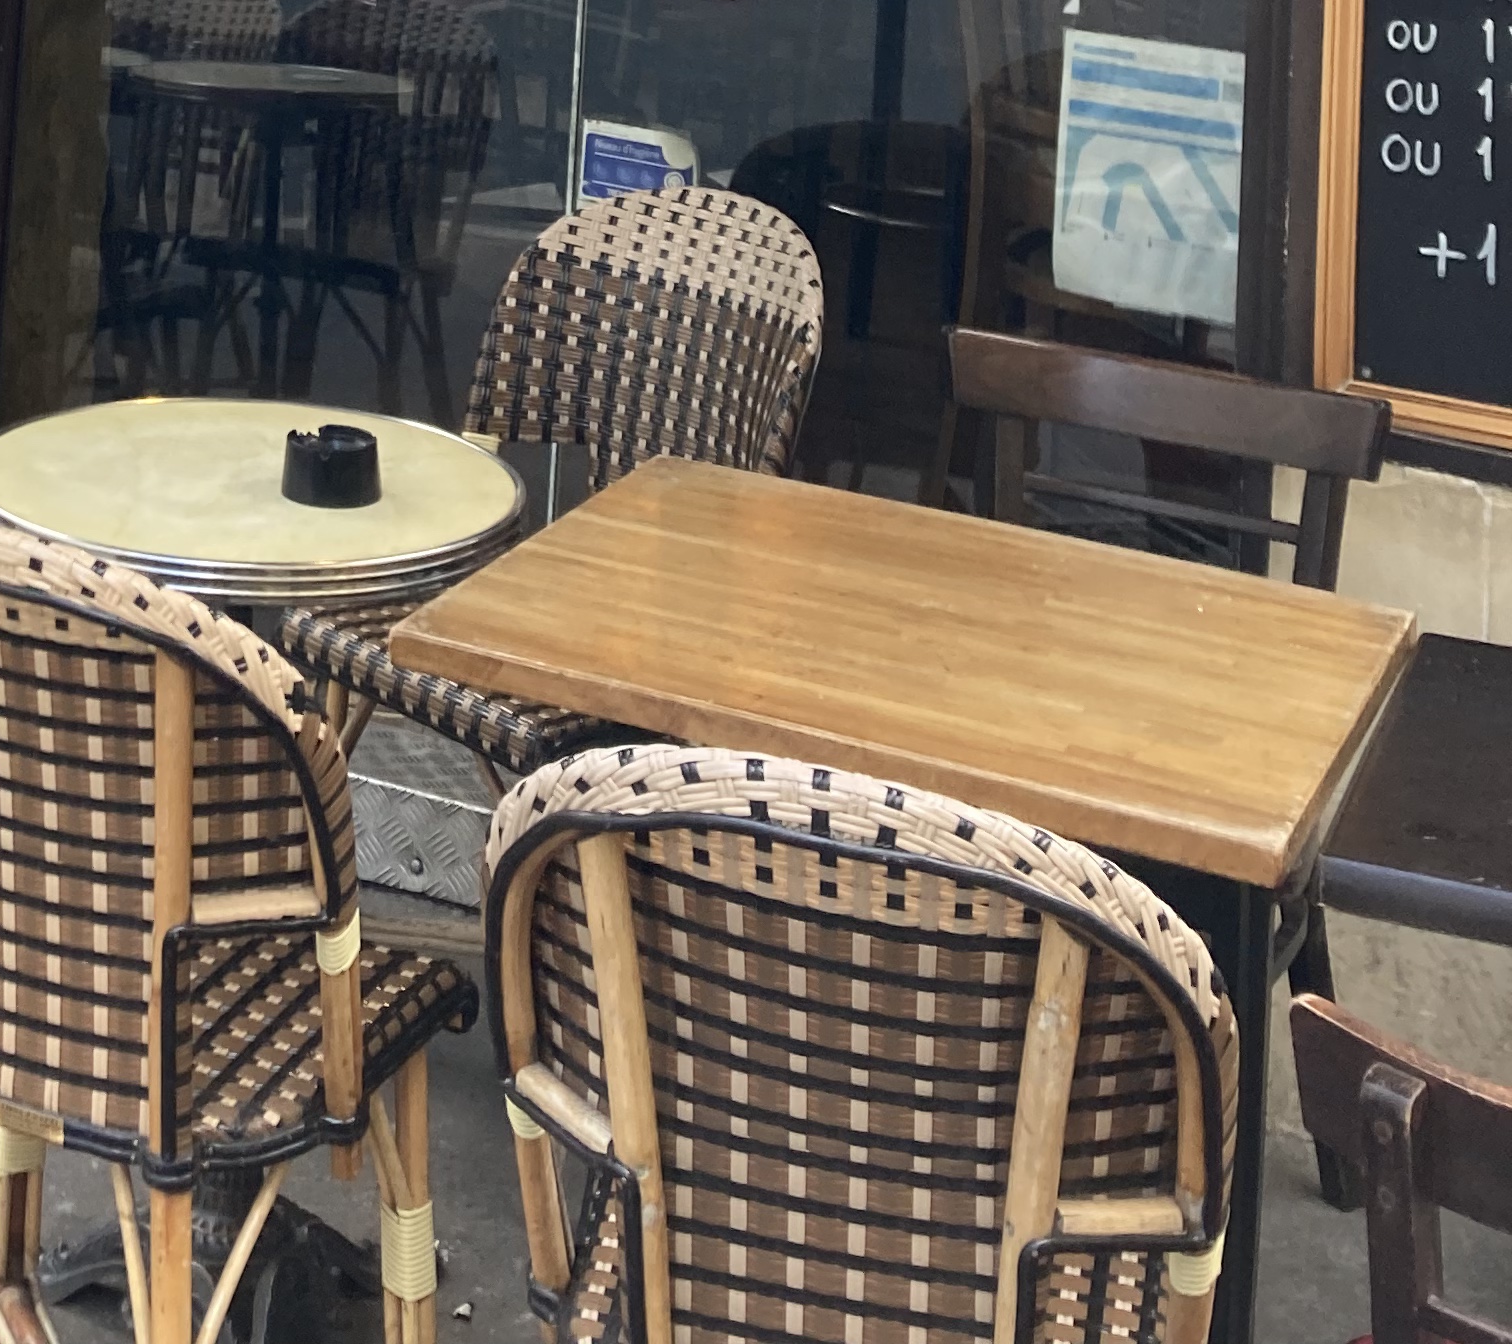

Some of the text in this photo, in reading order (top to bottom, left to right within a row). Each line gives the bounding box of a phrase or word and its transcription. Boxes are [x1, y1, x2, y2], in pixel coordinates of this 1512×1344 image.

[1482, 18, 1494, 63] 1
[1477, 77, 1494, 122] 1
[1476, 135, 1493, 181] 1
